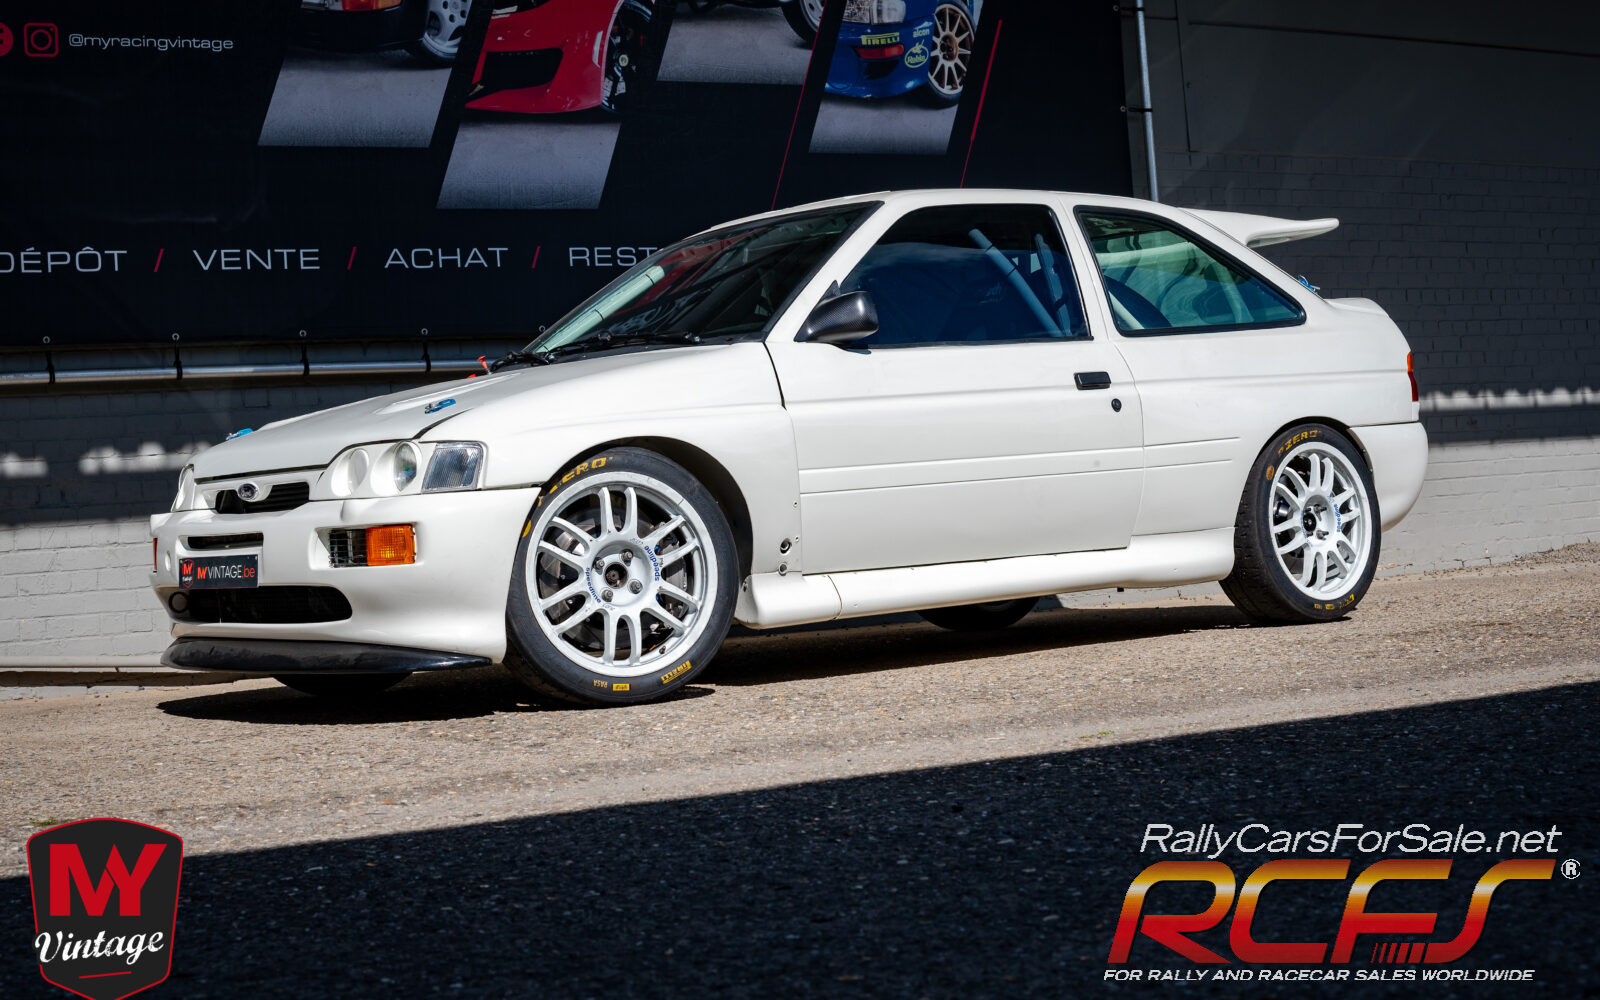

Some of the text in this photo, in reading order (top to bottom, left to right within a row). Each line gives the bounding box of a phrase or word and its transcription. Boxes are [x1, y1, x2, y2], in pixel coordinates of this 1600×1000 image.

[69, 34, 234, 51] @myracingvintage
[861, 32, 900, 45] PIRELLI
[0, 247, 127, 273] DÉPÔT
[193, 249, 320, 271] VENTE
[384, 247, 508, 269] ACHAT
[1285, 429, 1318, 451] ZERO
[197, 564, 256, 580] MYVINTAGE.be
[644, 545, 661, 582] speedline
